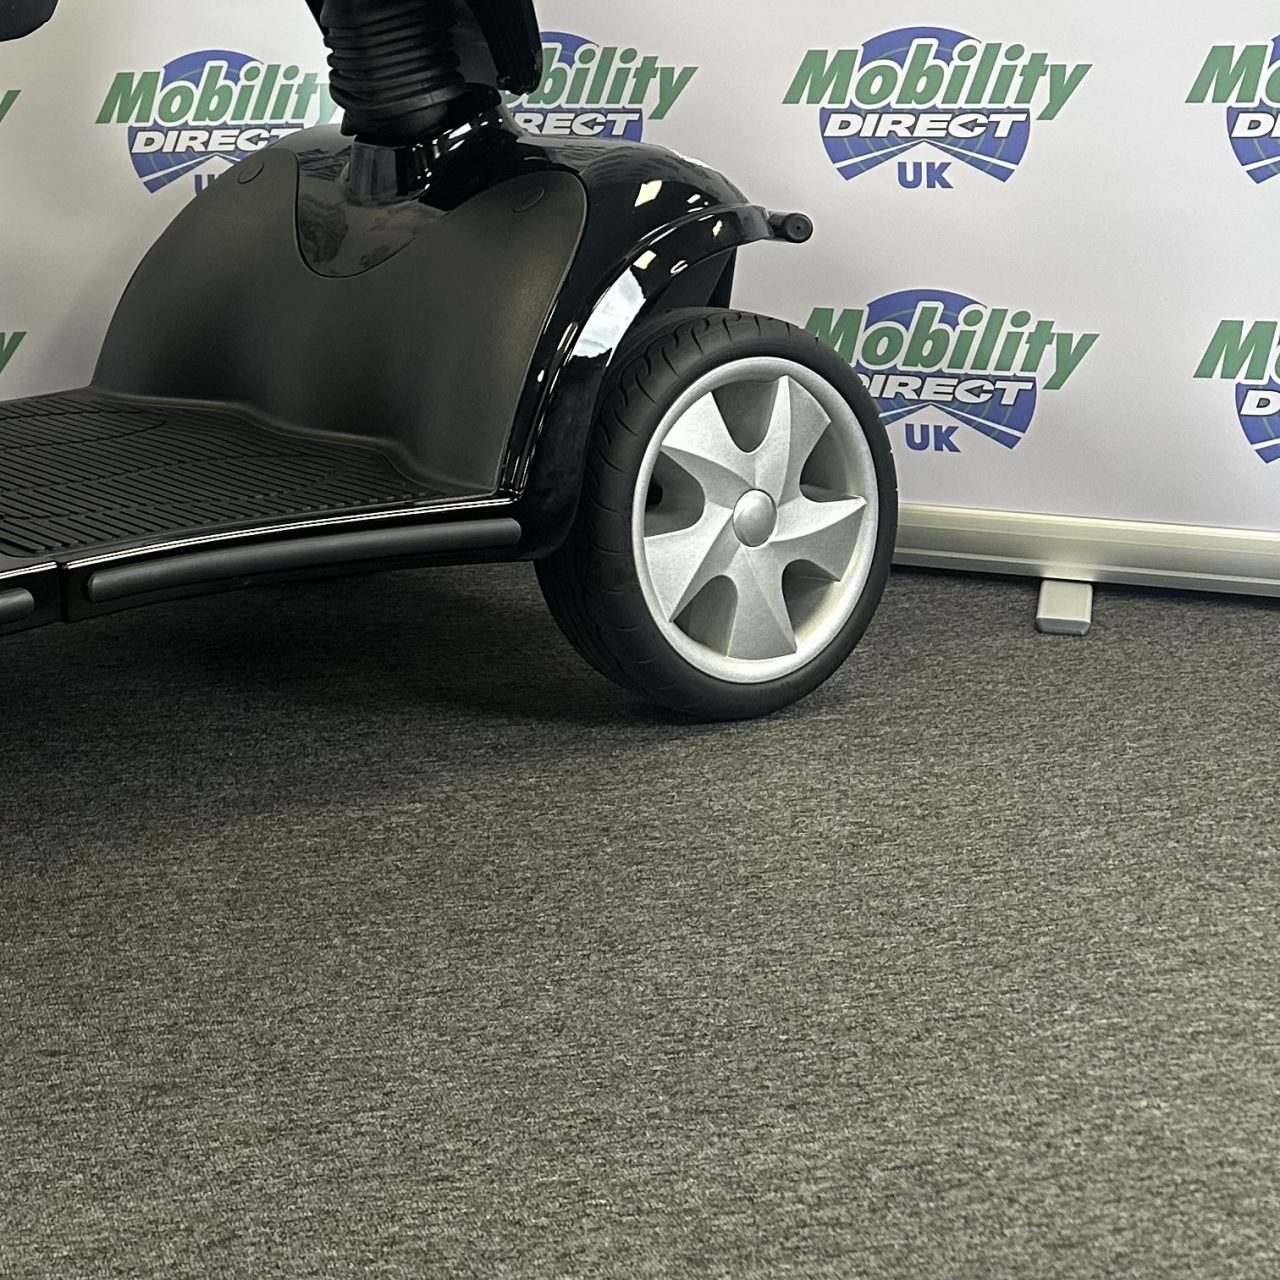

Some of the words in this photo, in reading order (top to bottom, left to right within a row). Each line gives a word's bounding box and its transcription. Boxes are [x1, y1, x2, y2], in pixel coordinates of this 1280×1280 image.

[501, 47, 699, 120] bility
[782, 43, 1093, 120] Mobility
[514, 113, 640, 136] RECT
[824, 113, 1028, 138] DIRECT
[897, 162, 954, 189] UK
[804, 306, 1100, 391] Mobility
[905, 424, 961, 453] UK
